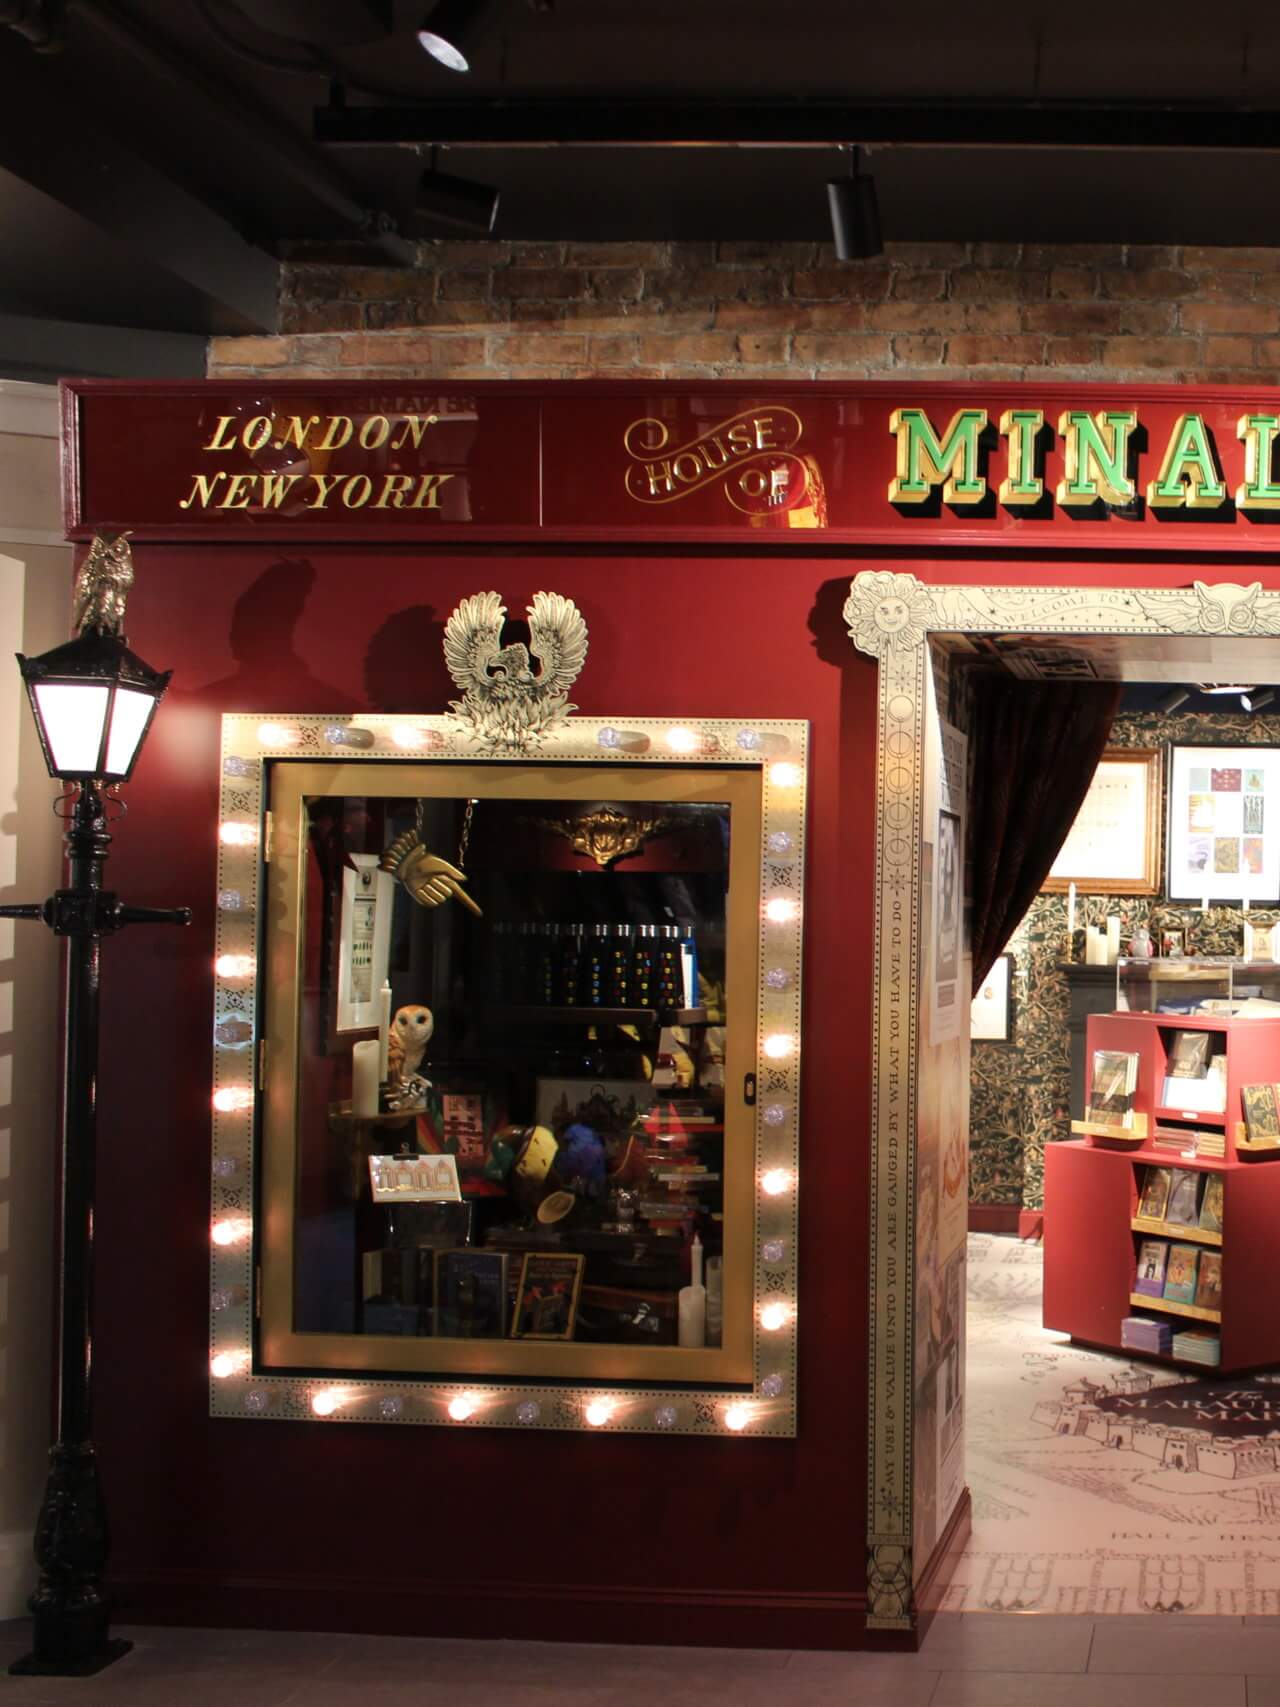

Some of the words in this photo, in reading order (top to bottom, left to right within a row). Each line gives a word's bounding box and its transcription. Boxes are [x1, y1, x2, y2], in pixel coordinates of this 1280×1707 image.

[202, 415, 438, 450] LONDON
[644, 417, 777, 496] HOUSE
[179, 471, 304, 509] NEW
[305, 474, 454, 509] YORK
[738, 467, 788, 497] OF
[1003, 594, 1088, 624] WELCOME
[1099, 592, 1119, 604] TO
[892, 900, 902, 921] DO
[891, 927, 902, 948] TO
[890, 952, 901, 1004] HAVE
[889, 1009, 900, 1041] YOU
[888, 1046, 900, 1104] WHAT
[888, 1110, 899, 1134] BY
[887, 1137, 899, 1207] GAUGED
[887, 1211, 898, 1252] ARE
[887, 1256, 897, 1288] YOU
[886, 1294, 897, 1339] UNTO
[885, 1344, 896, 1402] VALUE
[1208, 1391, 1264, 1400] The
[885, 1405, 896, 1421] &
[885, 1424, 896, 1455] USE
[885, 1458, 896, 1487] MY
